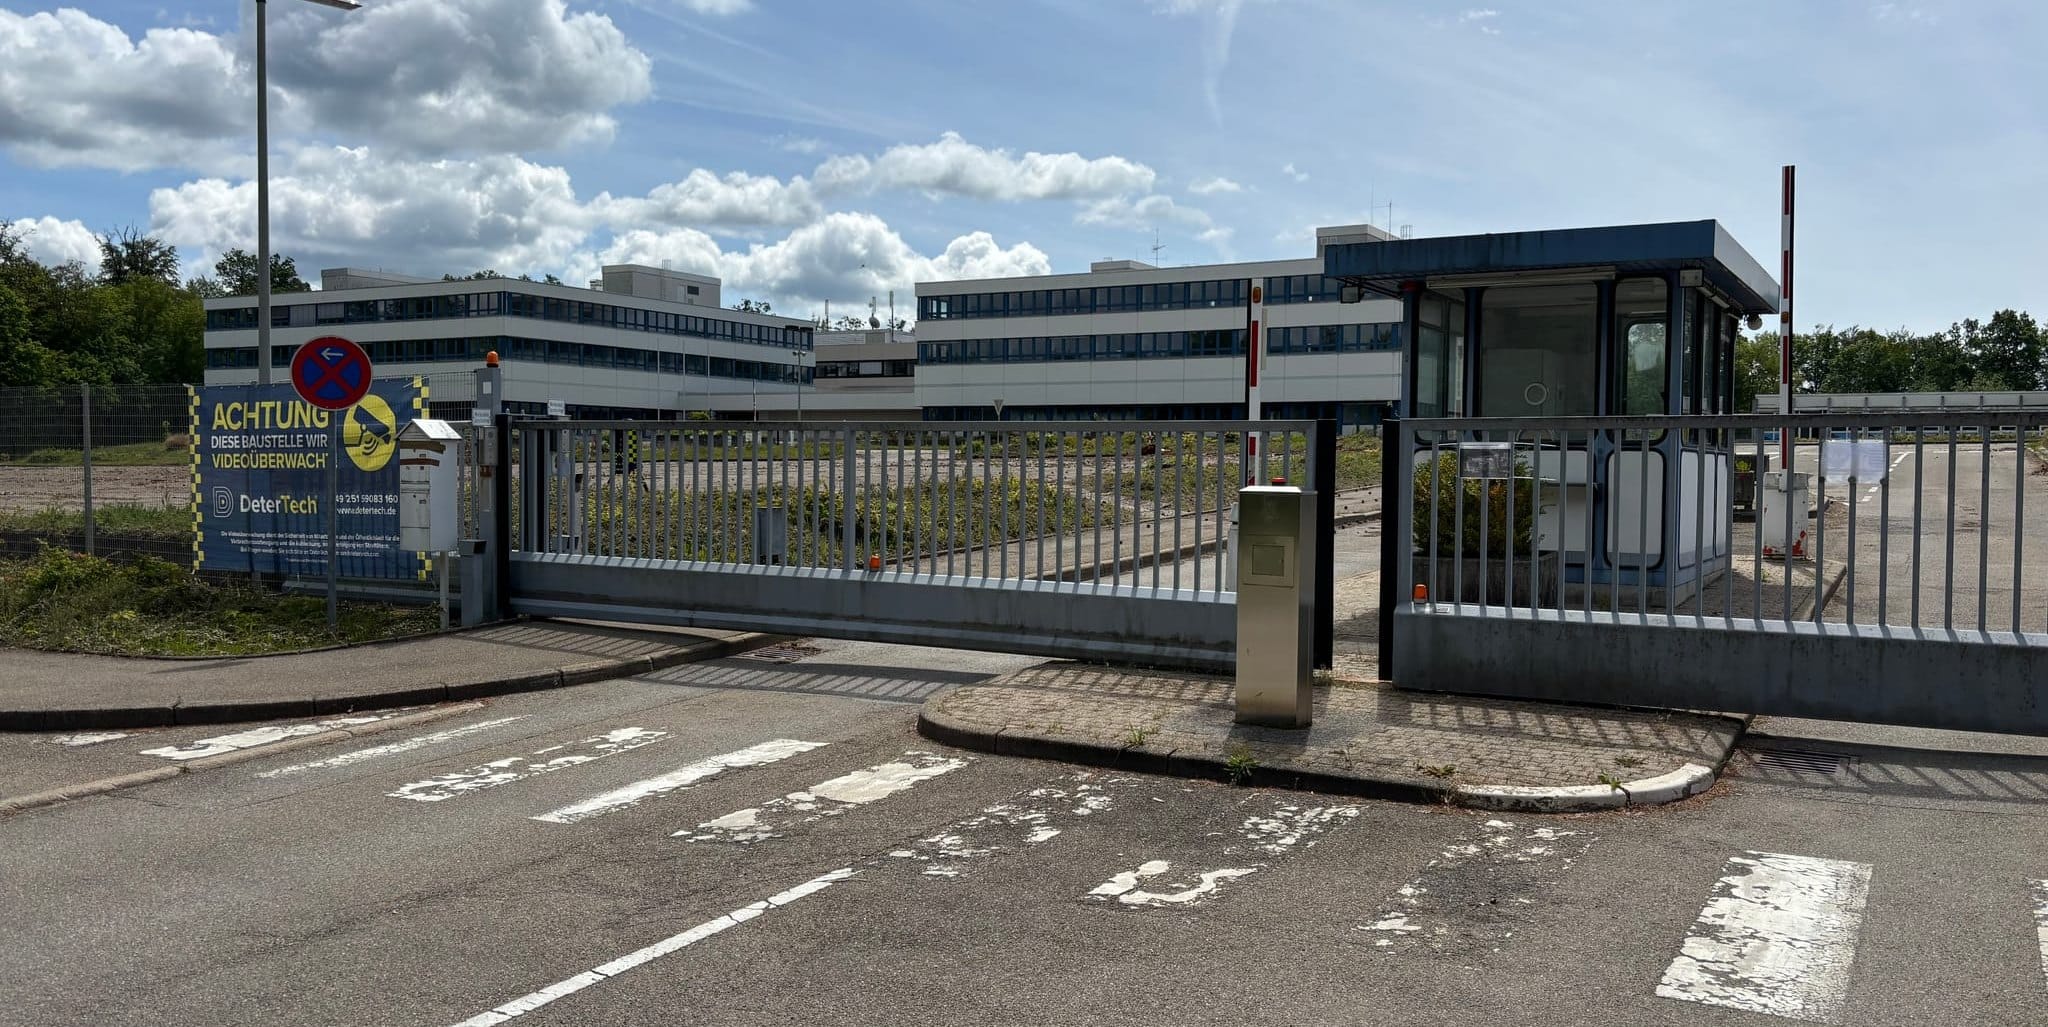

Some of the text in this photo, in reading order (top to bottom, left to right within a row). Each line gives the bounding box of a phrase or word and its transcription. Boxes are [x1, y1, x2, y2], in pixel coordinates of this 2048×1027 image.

[212, 400, 329, 431] ACHTUNG
[211, 433, 328, 449] DIESE BAUSTELLE WIR
[240, 494, 318, 515] DeterTech
